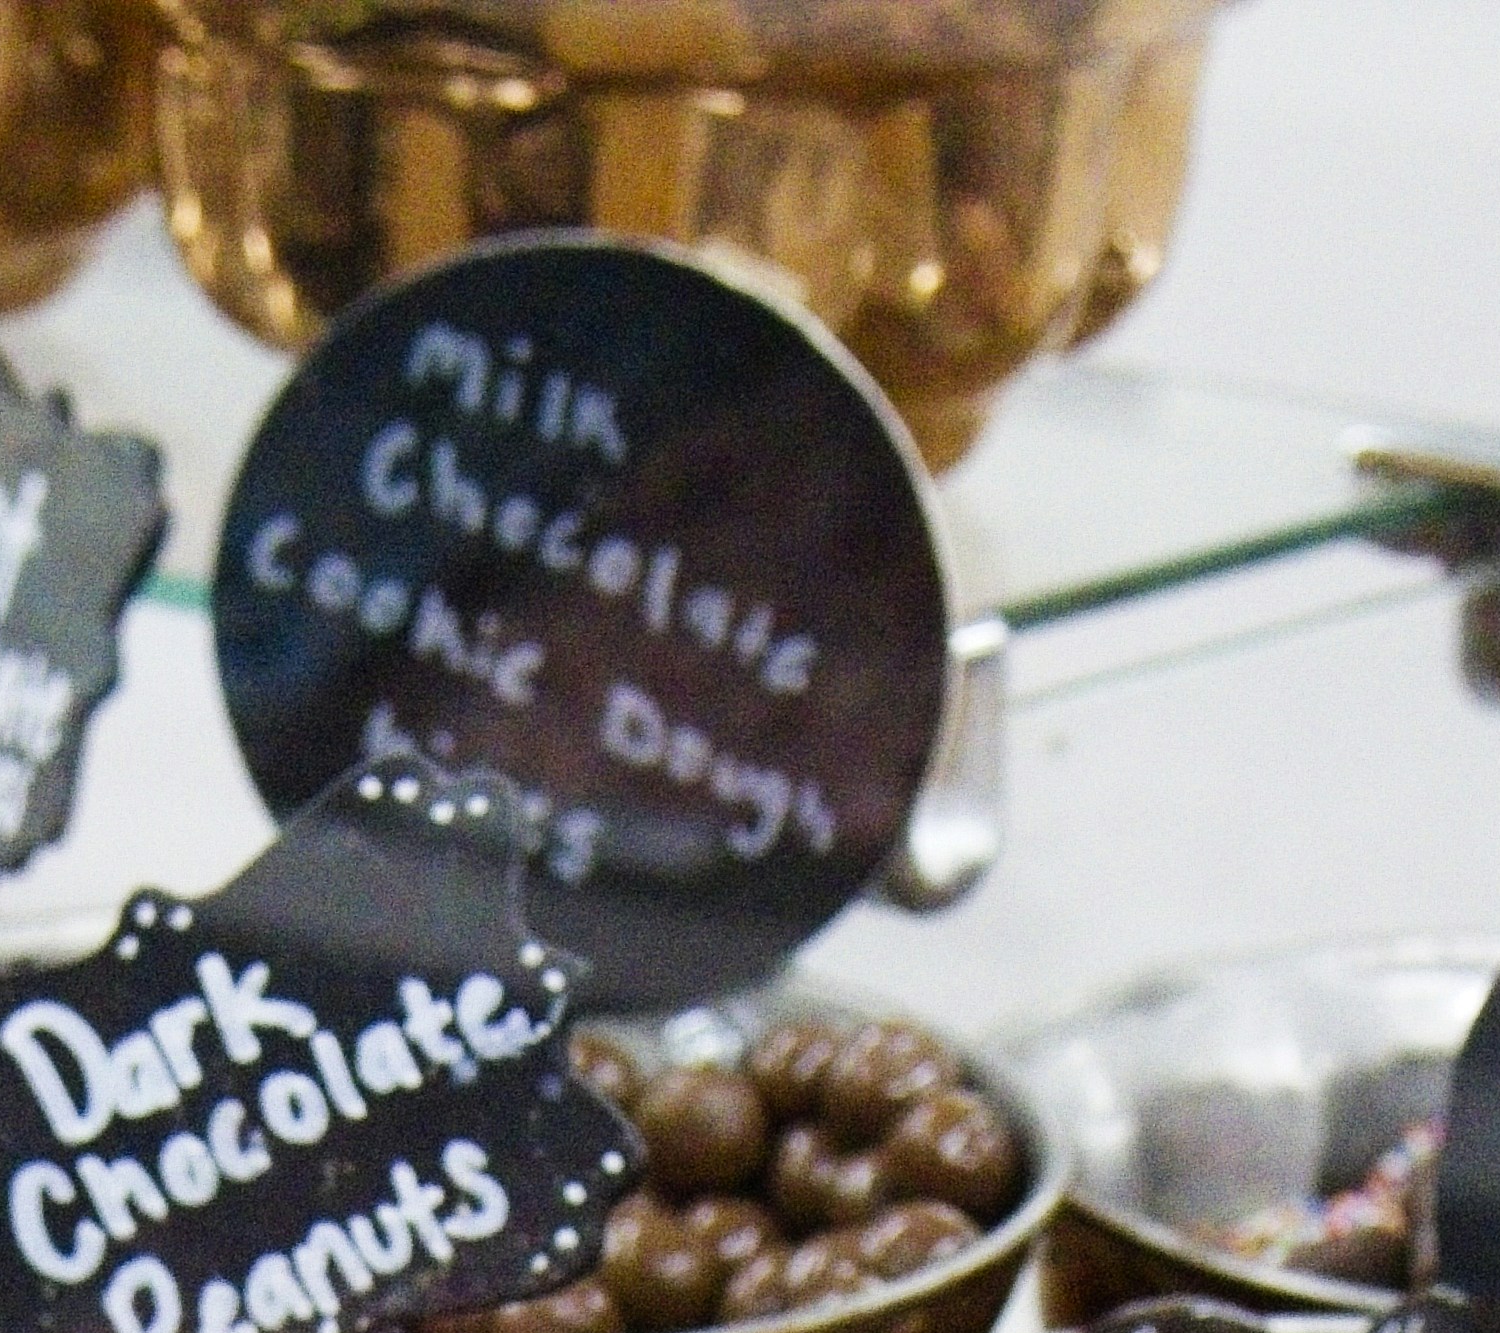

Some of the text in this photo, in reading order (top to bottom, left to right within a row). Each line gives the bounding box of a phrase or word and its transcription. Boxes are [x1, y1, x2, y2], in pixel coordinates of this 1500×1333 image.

[361, 416, 820, 697] Chocolate
[0, 950, 318, 1146] Dark
[9, 972, 552, 1286] Chocolate
